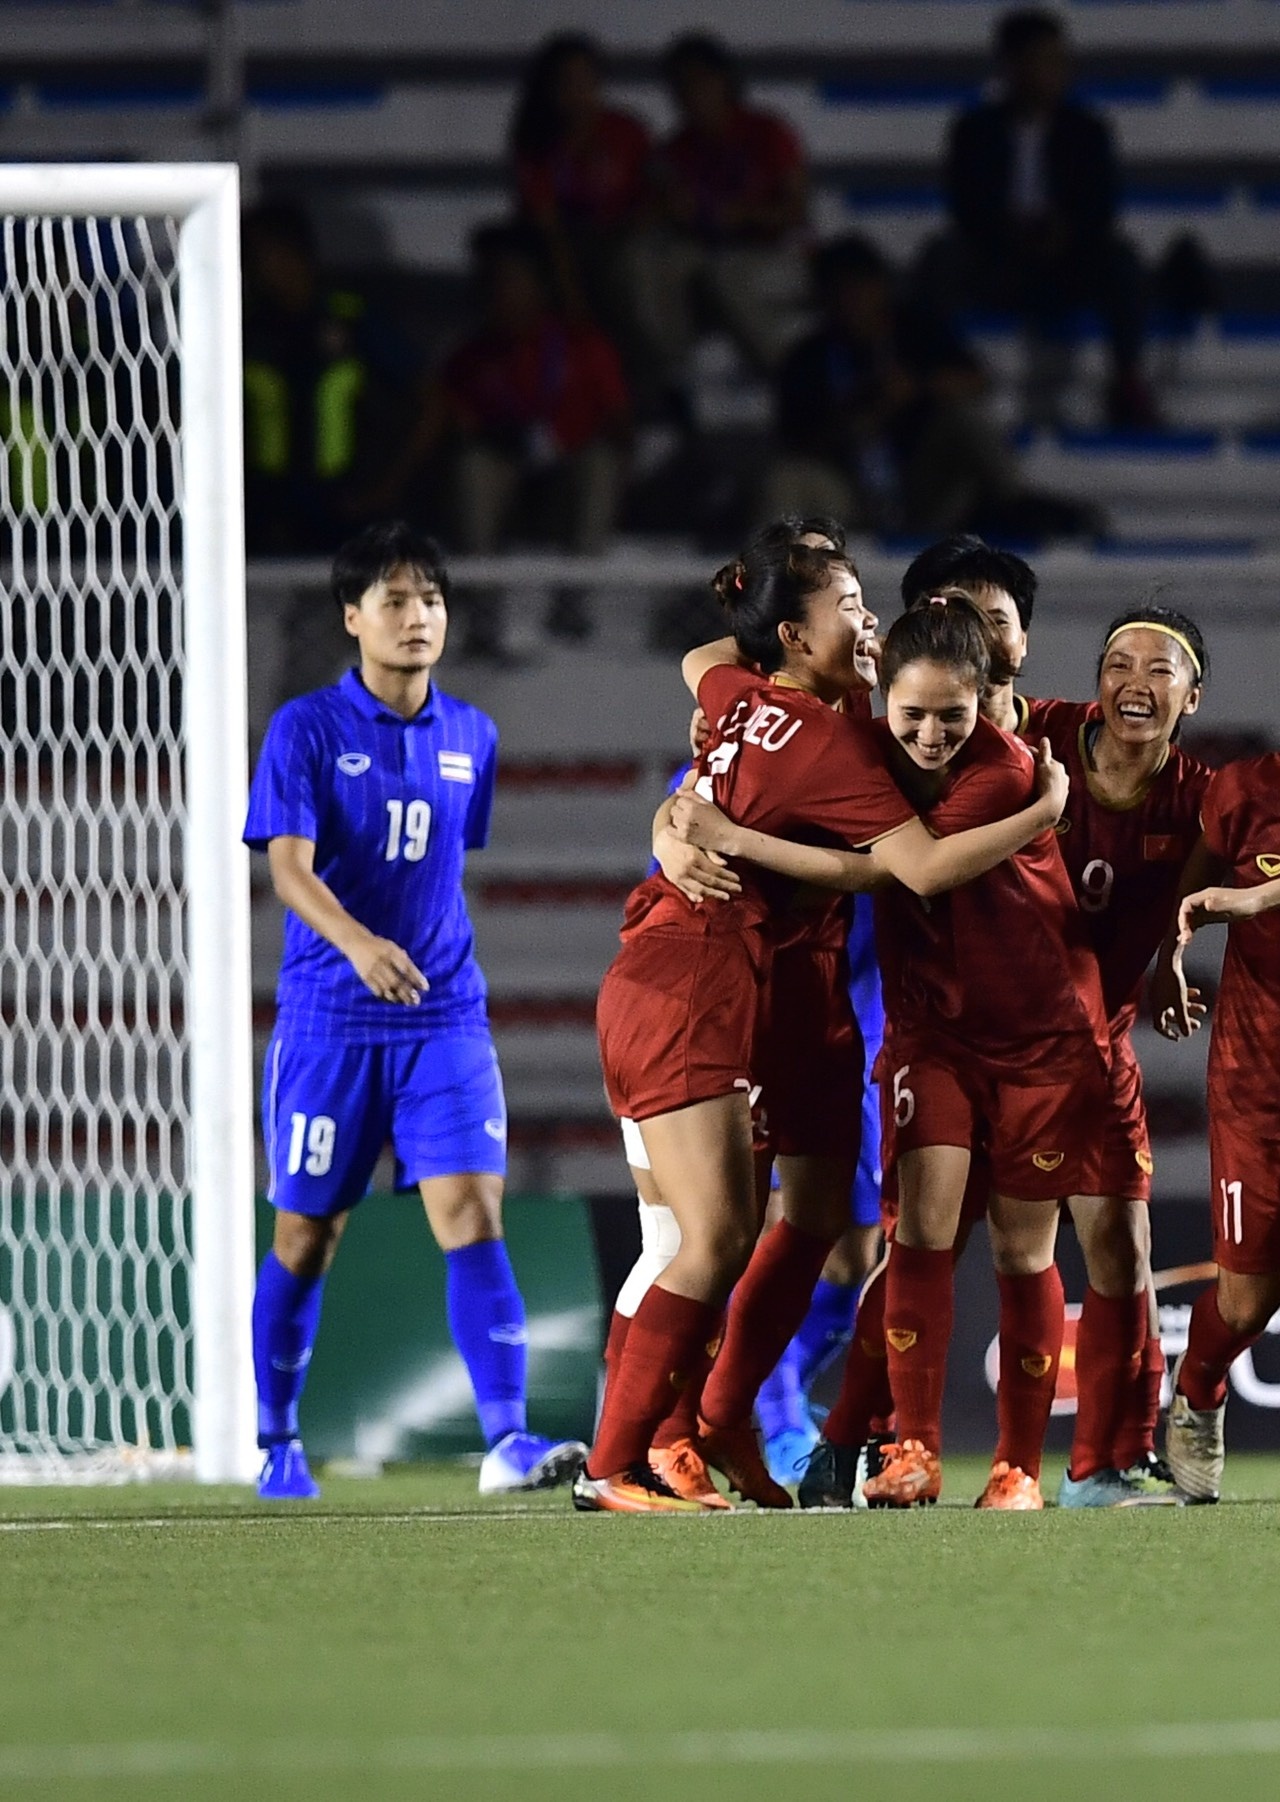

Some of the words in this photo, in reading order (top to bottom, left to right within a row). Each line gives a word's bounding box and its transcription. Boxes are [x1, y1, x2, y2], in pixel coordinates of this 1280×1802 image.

[386, 799, 431, 862] 19
[1080, 859, 1114, 911] 9
[288, 1112, 336, 1176] 19
[1220, 1178, 1243, 1245] 11
